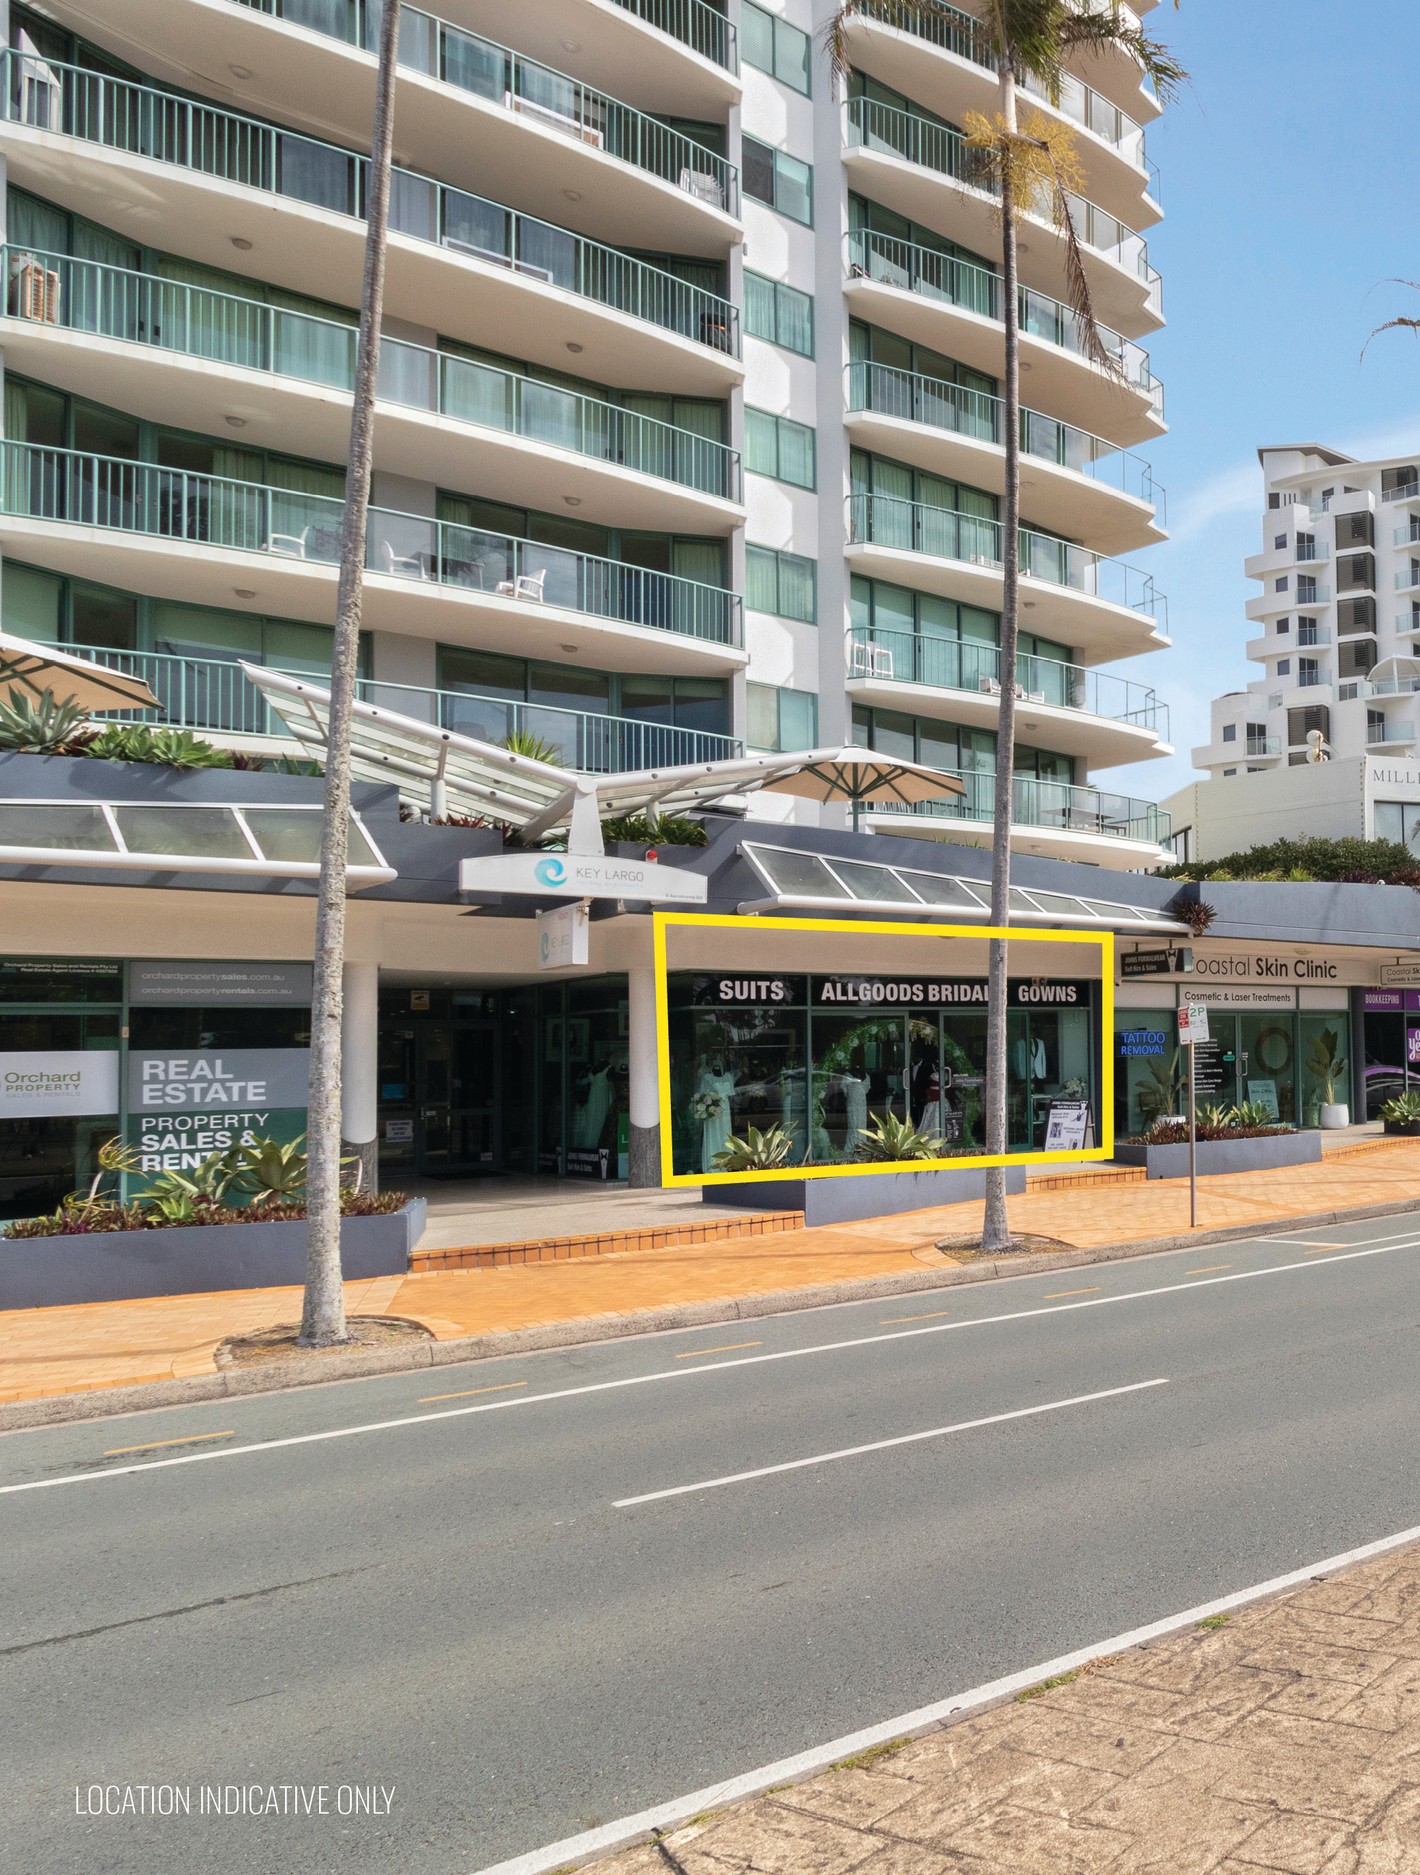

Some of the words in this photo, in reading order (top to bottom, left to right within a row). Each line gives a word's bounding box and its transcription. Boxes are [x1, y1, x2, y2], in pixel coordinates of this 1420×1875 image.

[576, 868, 600, 878] KEY
[605, 870, 644, 882] LARGO
[1195, 956, 1250, 976] oastal
[1256, 957, 1288, 977] Skin
[1294, 960, 1338, 978] Clinic
[142, 972, 285, 981] orchardpropertysales.com.au
[719, 980, 784, 1001] SUITS
[821, 982, 924, 1001] ALLGOODS
[1018, 985, 1077, 1002] GOWNS
[1184, 992, 1221, 1001] Cosmetic
[1231, 993, 1250, 1002] Laser
[1252, 993, 1291, 1002] Treatments
[1365, 994, 1400, 1004] BOOKKEEPING
[1190, 1007, 1205, 1017] 2P
[1121, 1032, 1165, 1043] TATTOO
[1121, 1046, 1165, 1055] REMOVAL
[143, 1059, 234, 1080] REAL
[4, 1071, 81, 1083] Orchard
[6, 1083, 80, 1092] PROPERTY
[142, 1081, 267, 1104] ESTATE
[142, 1113, 269, 1132] PROPERTY
[141, 1131, 232, 1152] SALES
[240, 1130, 257, 1148] &
